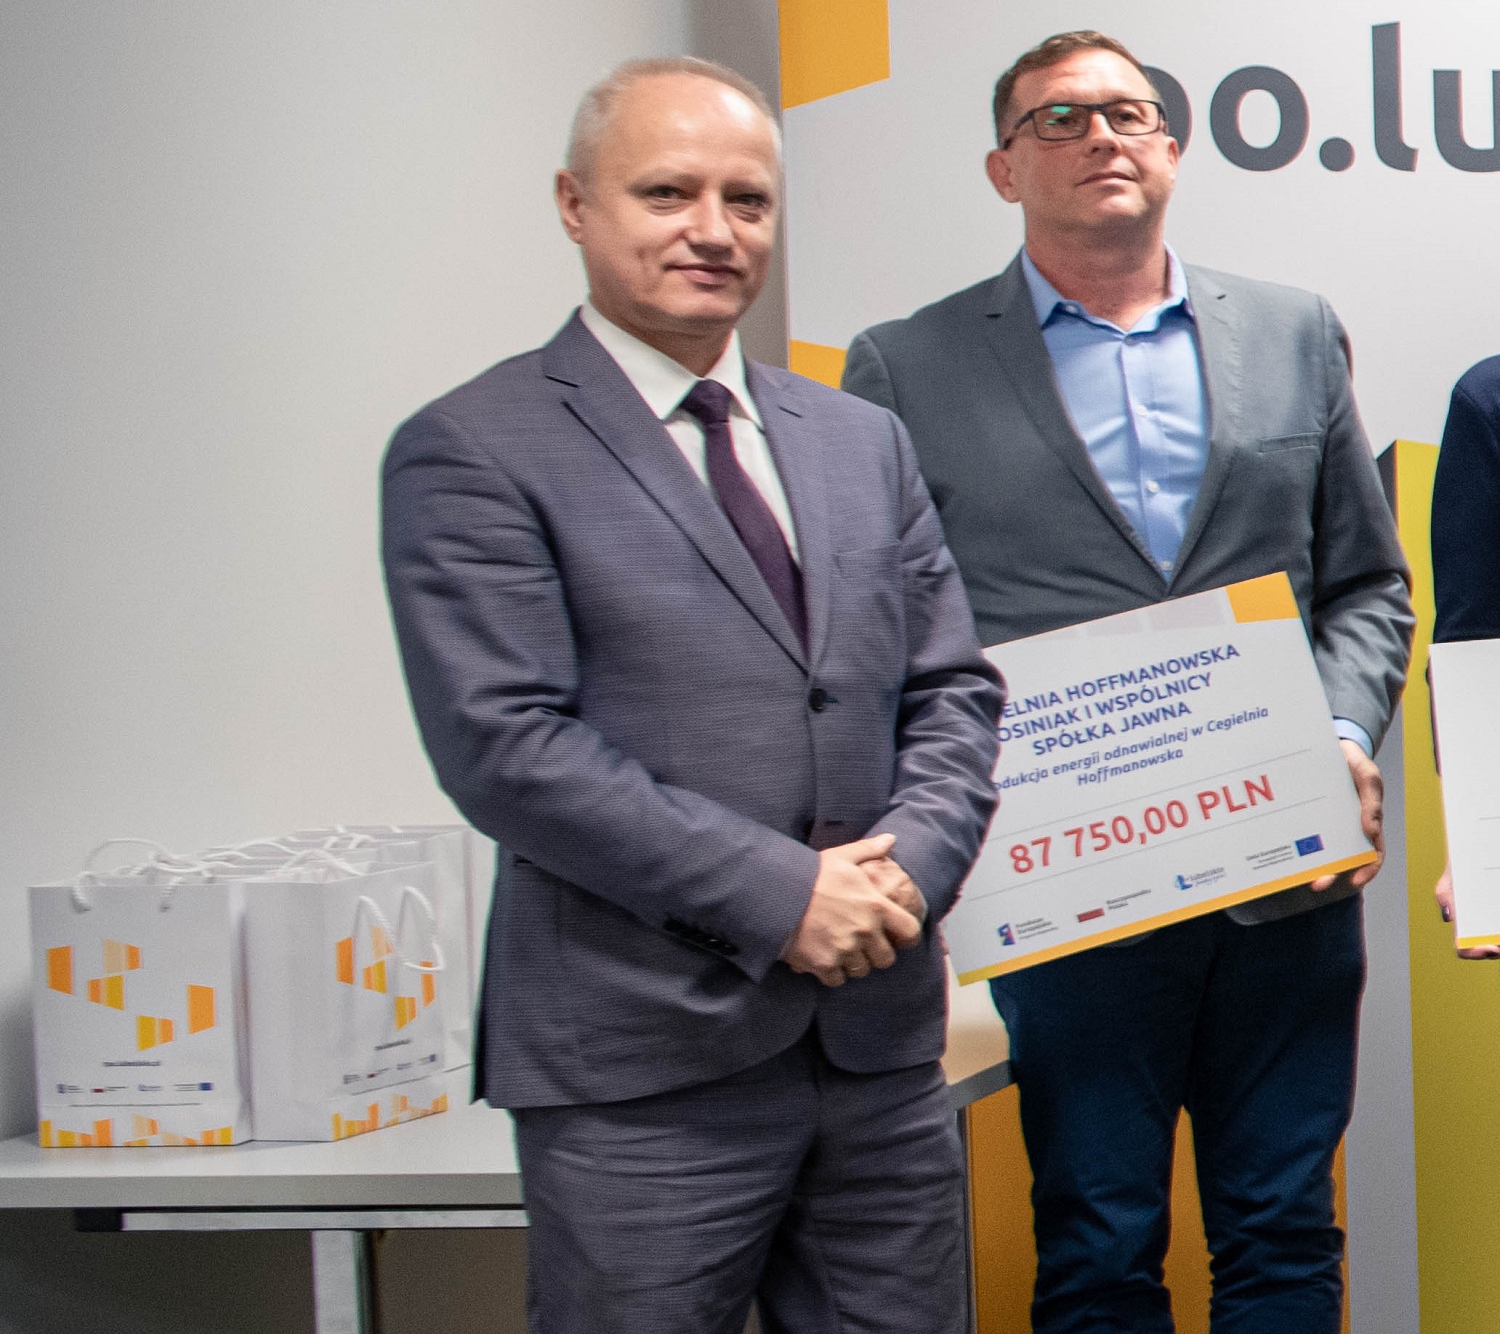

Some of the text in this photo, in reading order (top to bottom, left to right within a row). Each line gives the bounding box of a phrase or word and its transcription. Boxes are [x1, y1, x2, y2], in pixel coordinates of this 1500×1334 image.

[1003, 644, 1241, 719] ELNIA HOFFMANOWSKA
[1093, 671, 1211, 716] WSPÓLNICY
[1032, 701, 1193, 756] SPÓŁKA JAWNA
[1009, 836, 1052, 874] 87
[1063, 799, 1189, 858] 750,00
[1196, 774, 1275, 821] PLN
